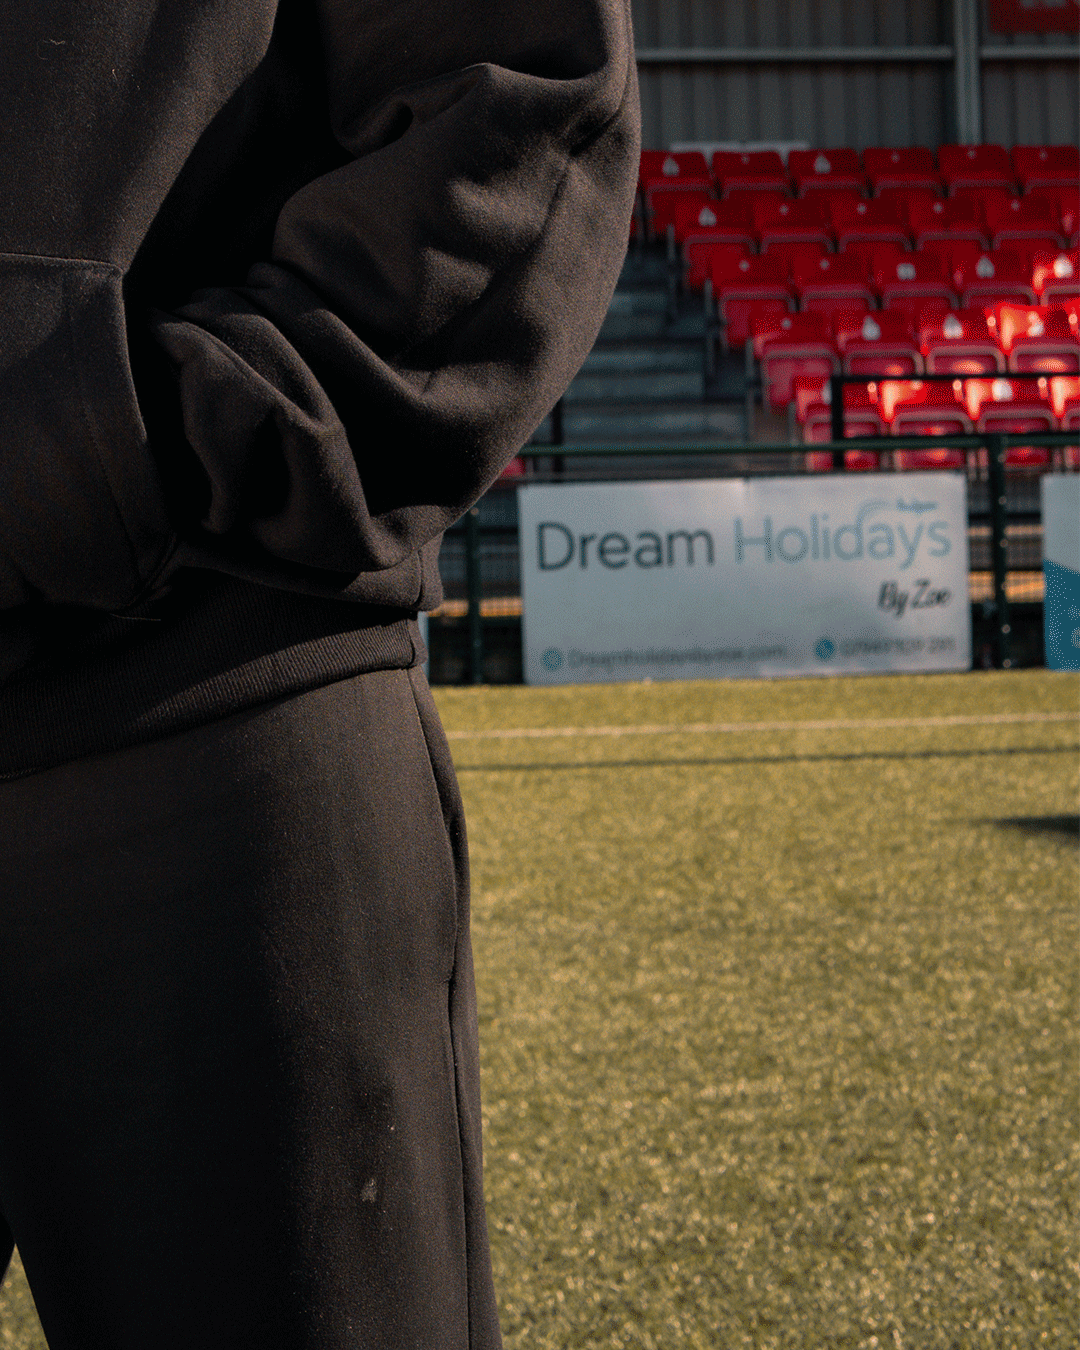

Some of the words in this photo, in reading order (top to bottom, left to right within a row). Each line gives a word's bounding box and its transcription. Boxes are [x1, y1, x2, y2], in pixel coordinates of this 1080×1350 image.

[536, 521, 715, 571] Dream
[734, 499, 952, 570] Holidays
[877, 580, 909, 618] By
[911, 578, 951, 609] Zoe
